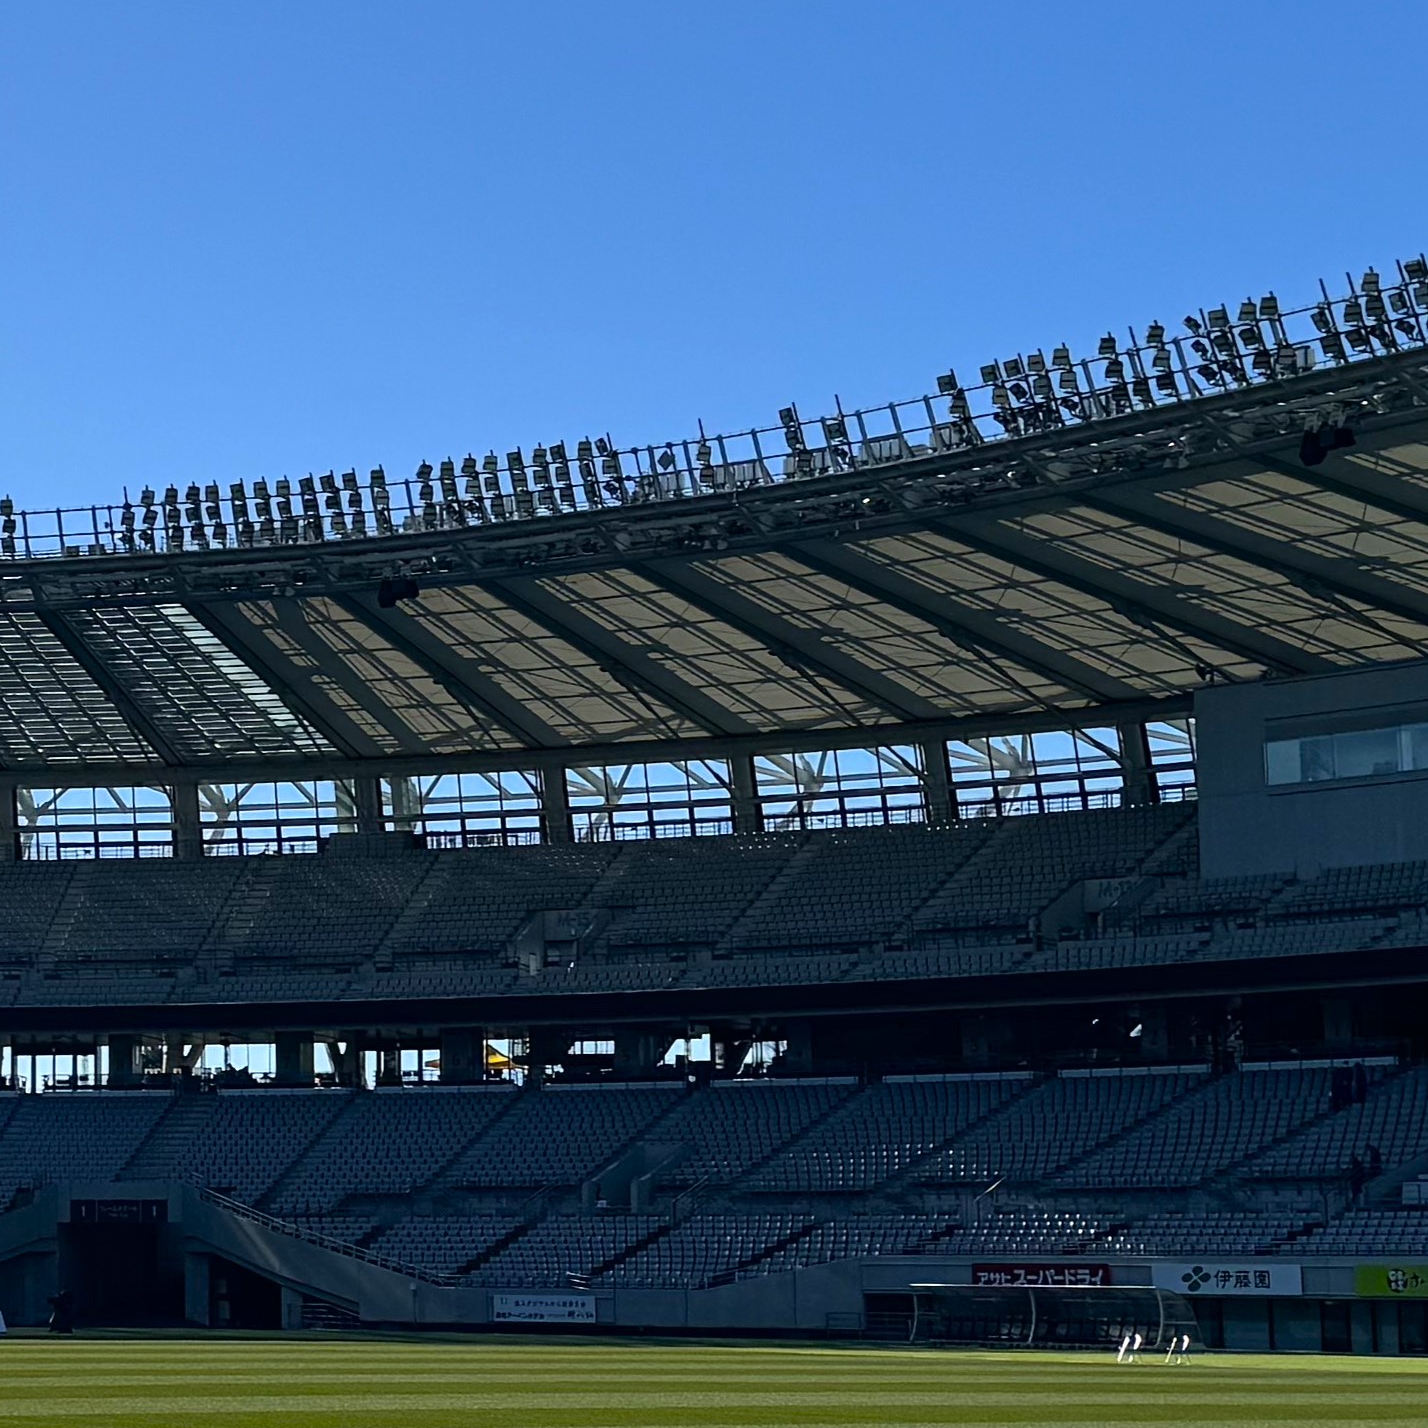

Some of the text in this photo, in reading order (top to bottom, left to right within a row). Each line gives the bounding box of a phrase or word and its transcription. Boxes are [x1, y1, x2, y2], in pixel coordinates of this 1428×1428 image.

[1013, 1269, 1104, 1286] スーパードライ
[1215, 1269, 1271, 1289] 伊藤園
